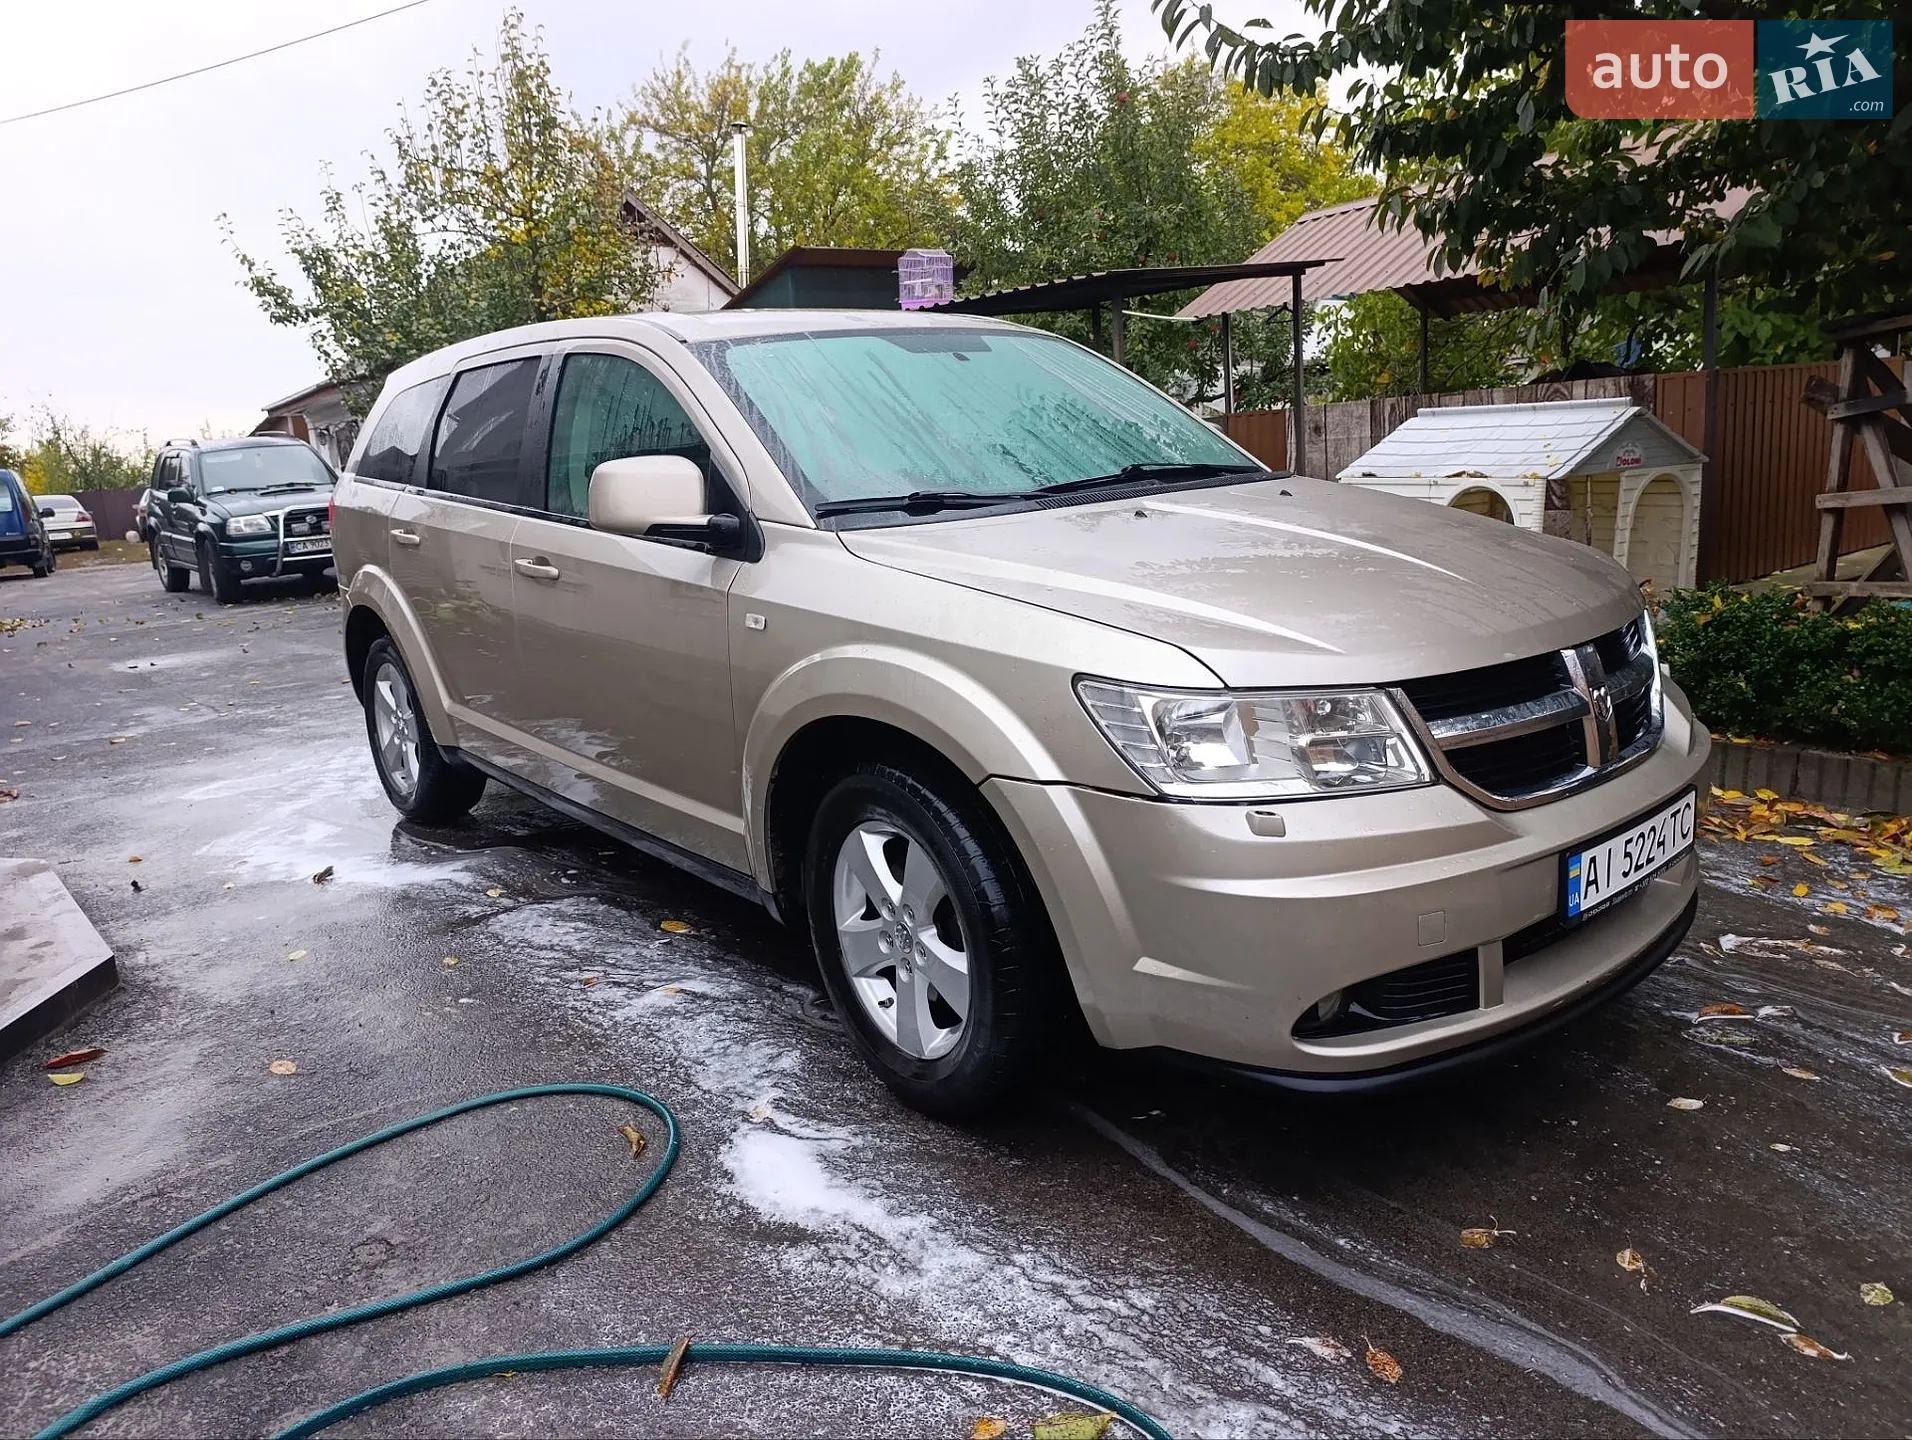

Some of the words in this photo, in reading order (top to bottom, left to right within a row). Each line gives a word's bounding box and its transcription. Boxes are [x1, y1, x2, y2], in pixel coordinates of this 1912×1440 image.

[1583, 847, 1612, 900] AI
[1621, 817, 1668, 879] 5224
[1669, 802, 1692, 848] TC
[1568, 891, 1580, 907] UA
